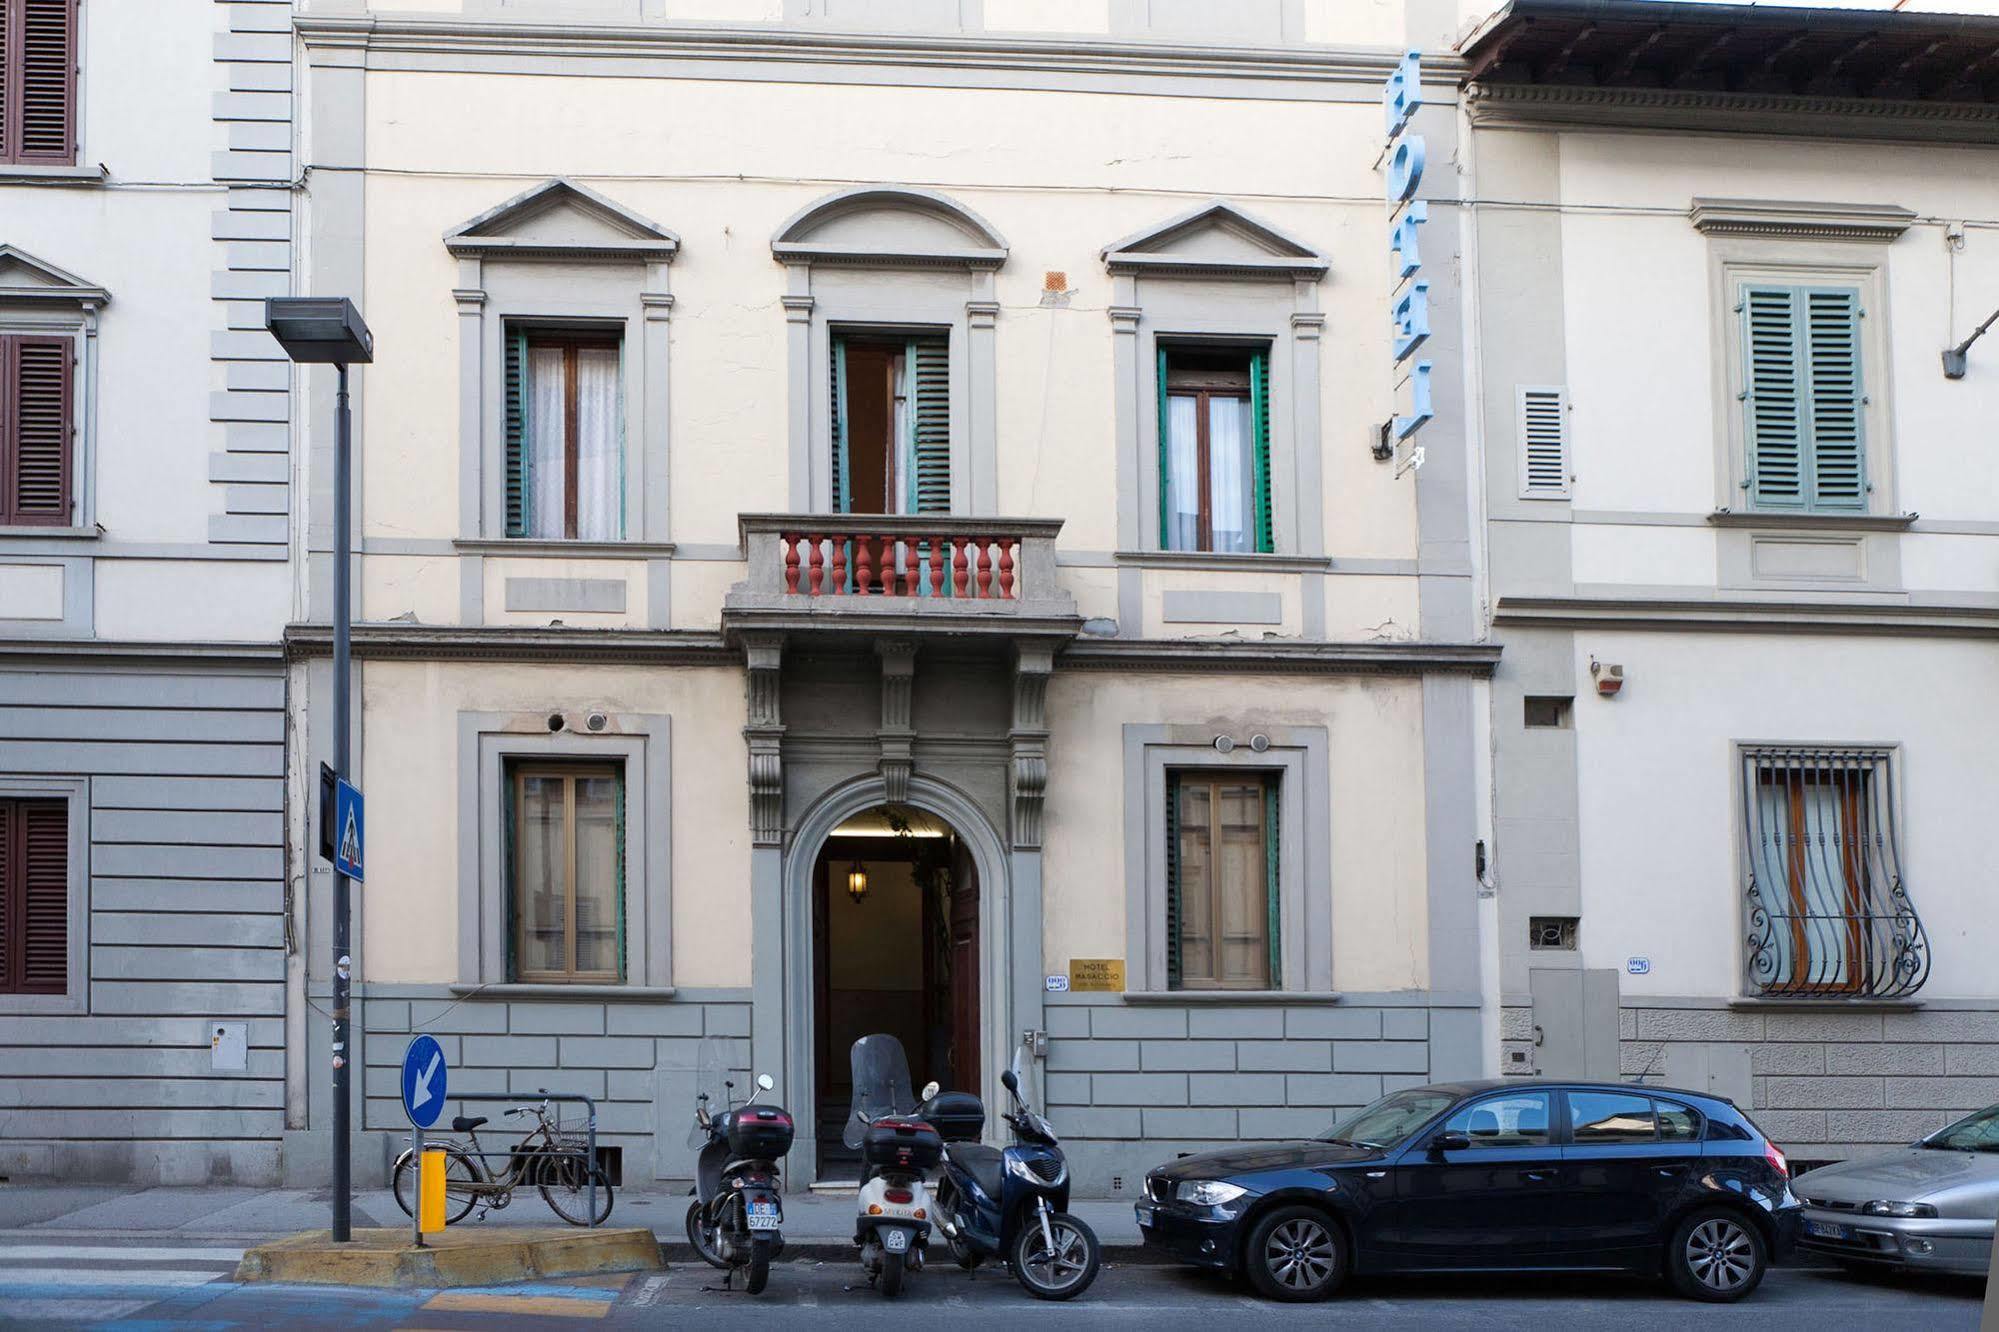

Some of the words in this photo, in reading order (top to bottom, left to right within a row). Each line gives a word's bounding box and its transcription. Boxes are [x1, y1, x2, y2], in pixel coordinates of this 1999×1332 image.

[1084, 963, 1110, 971] HOTEL
[1075, 973, 1119, 981] MASACCIO
[749, 1216, 777, 1228] 67272
